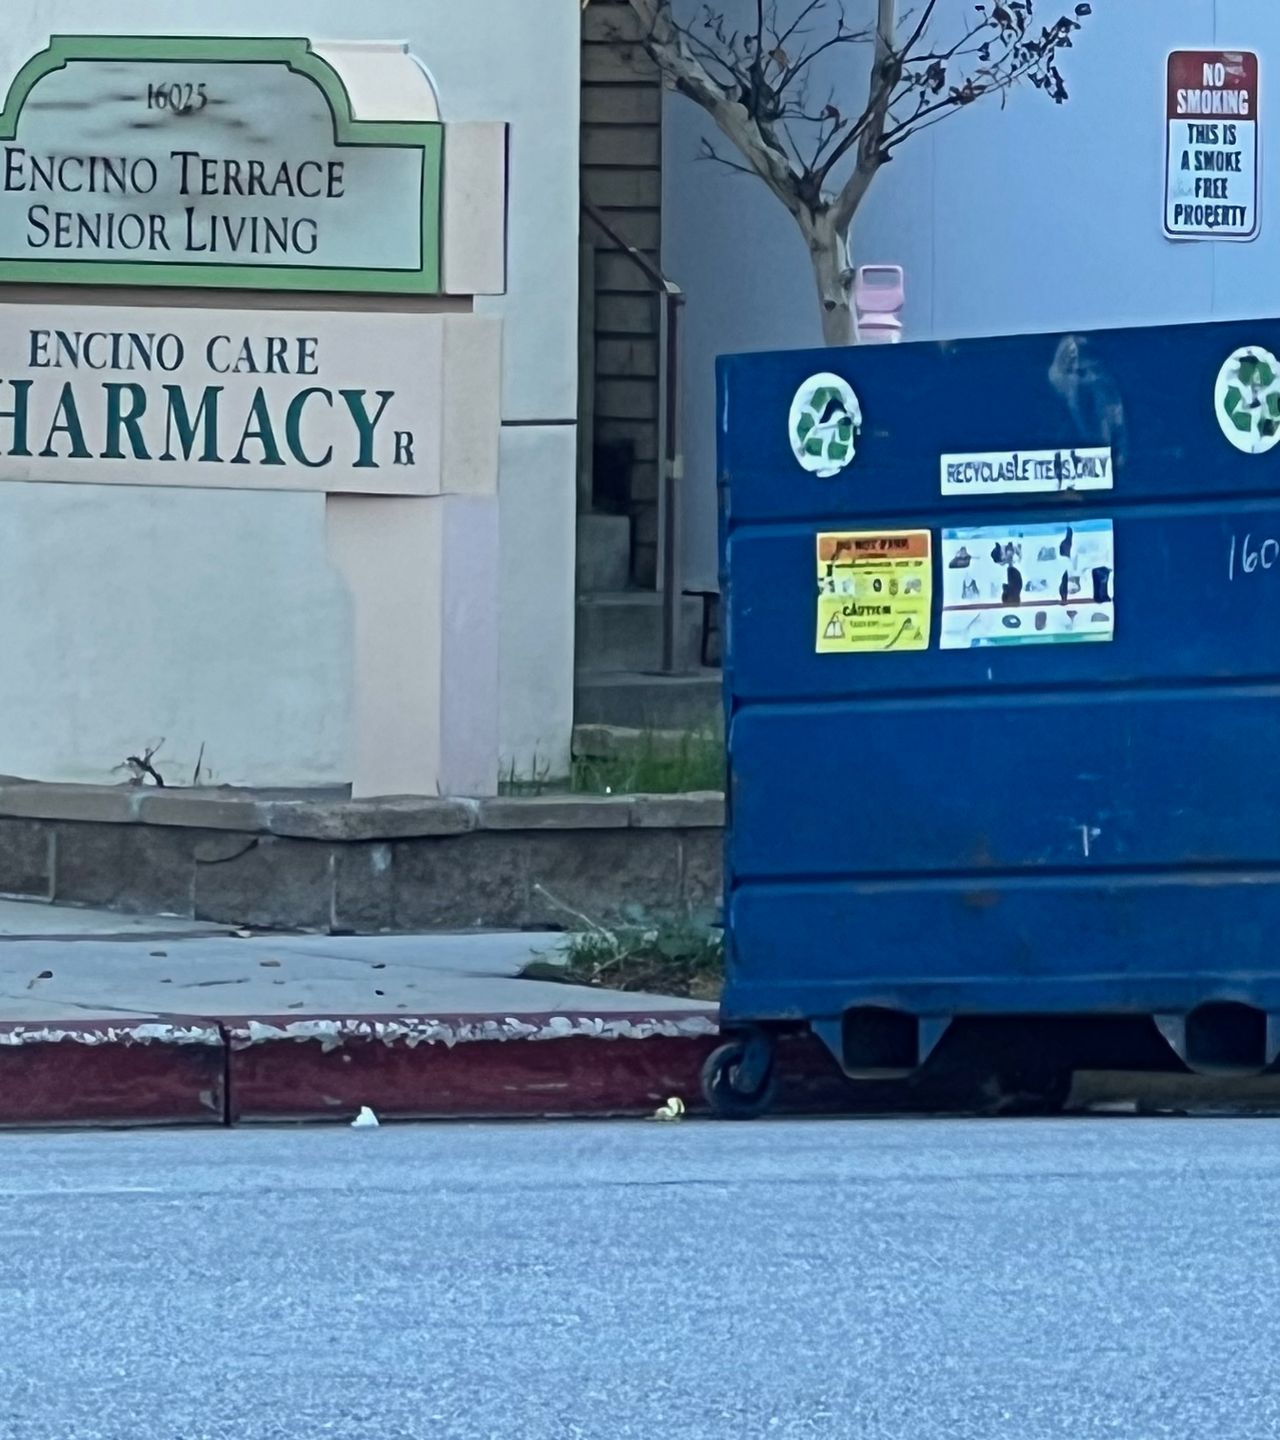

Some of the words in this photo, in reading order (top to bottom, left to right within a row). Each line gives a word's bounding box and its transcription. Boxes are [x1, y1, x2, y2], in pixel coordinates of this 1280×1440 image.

[1201, 62, 1226, 88] NO
[147, 82, 209, 113] 16025
[1175, 88, 1250, 116] SMOKING
[1186, 122, 1220, 146] THIS
[1222, 123, 1238, 146] IS
[3, 147, 159, 196] ENCINO
[170, 150, 346, 199] TERRACE
[1180, 149, 1191, 172] A
[1193, 150, 1243, 174] SMOKE
[1193, 177, 1230, 200] FREE
[26, 203, 172, 252] SENIOR
[183, 206, 320, 255] LIVING
[1173, 203, 1248, 229] PROPERTY
[27, 329, 185, 372] ENCINO
[206, 334, 320, 376] CARE
[1034, 457, 1070, 482] ITES
